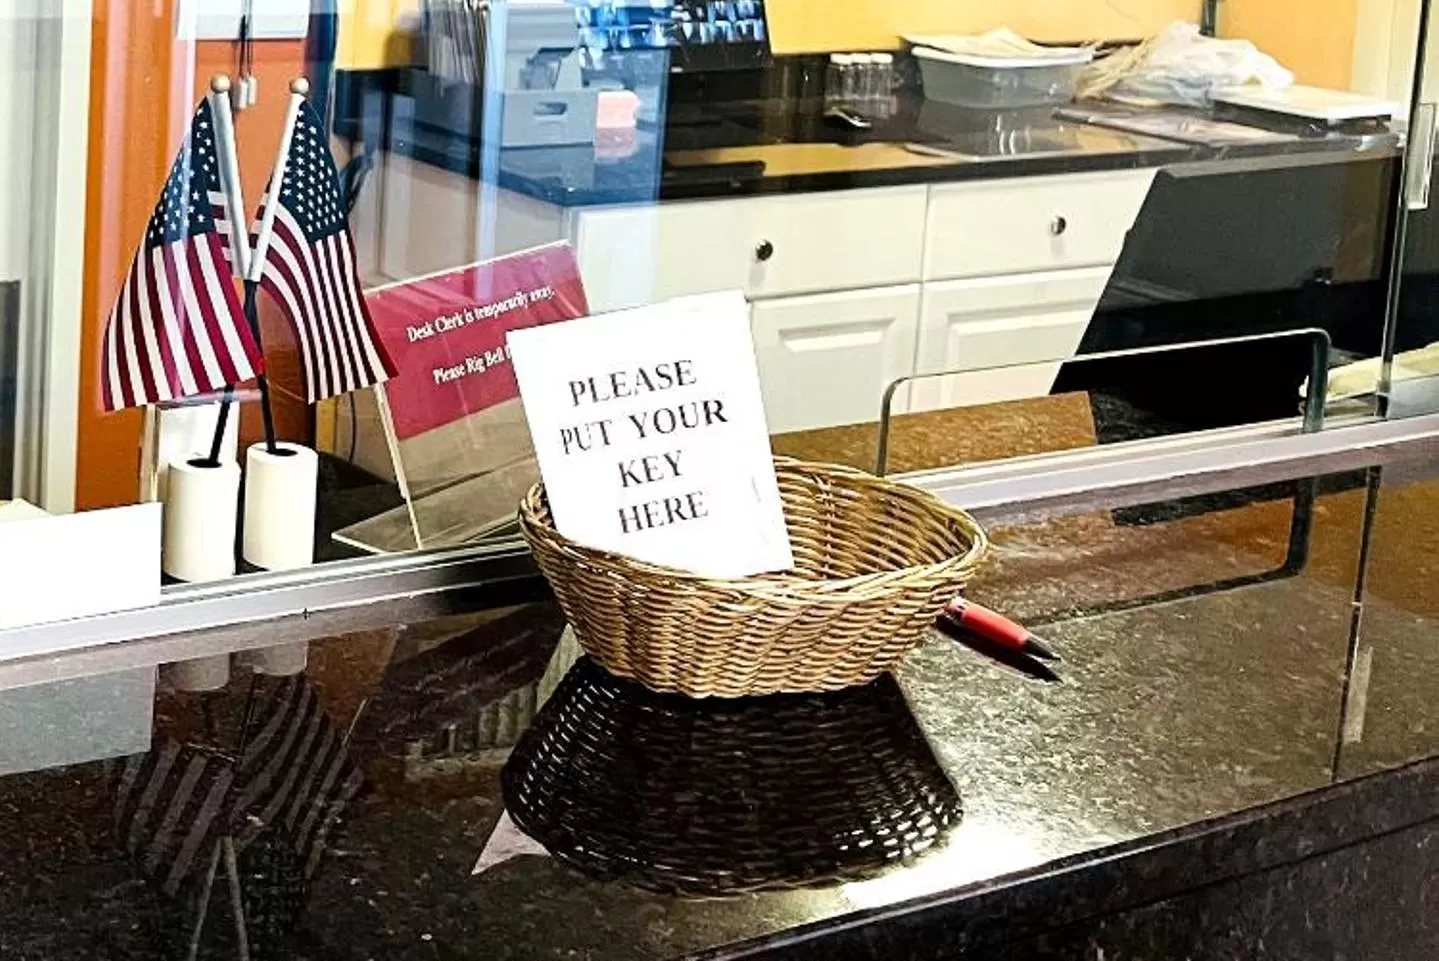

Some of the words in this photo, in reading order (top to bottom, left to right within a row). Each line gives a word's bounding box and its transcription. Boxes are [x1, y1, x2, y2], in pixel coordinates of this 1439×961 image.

[406, 320, 434, 342] Desk
[435, 312, 465, 333] Clerk
[464, 308, 474, 323] is
[474, 290, 529, 319] temporarily
[432, 364, 466, 385] Please
[484, 346, 505, 367] Bell
[569, 359, 696, 406] PLEASE
[560, 419, 613, 455] PUT
[628, 398, 729, 440] YOUR
[618, 449, 684, 488] KEY
[618, 490, 709, 534] HERE
